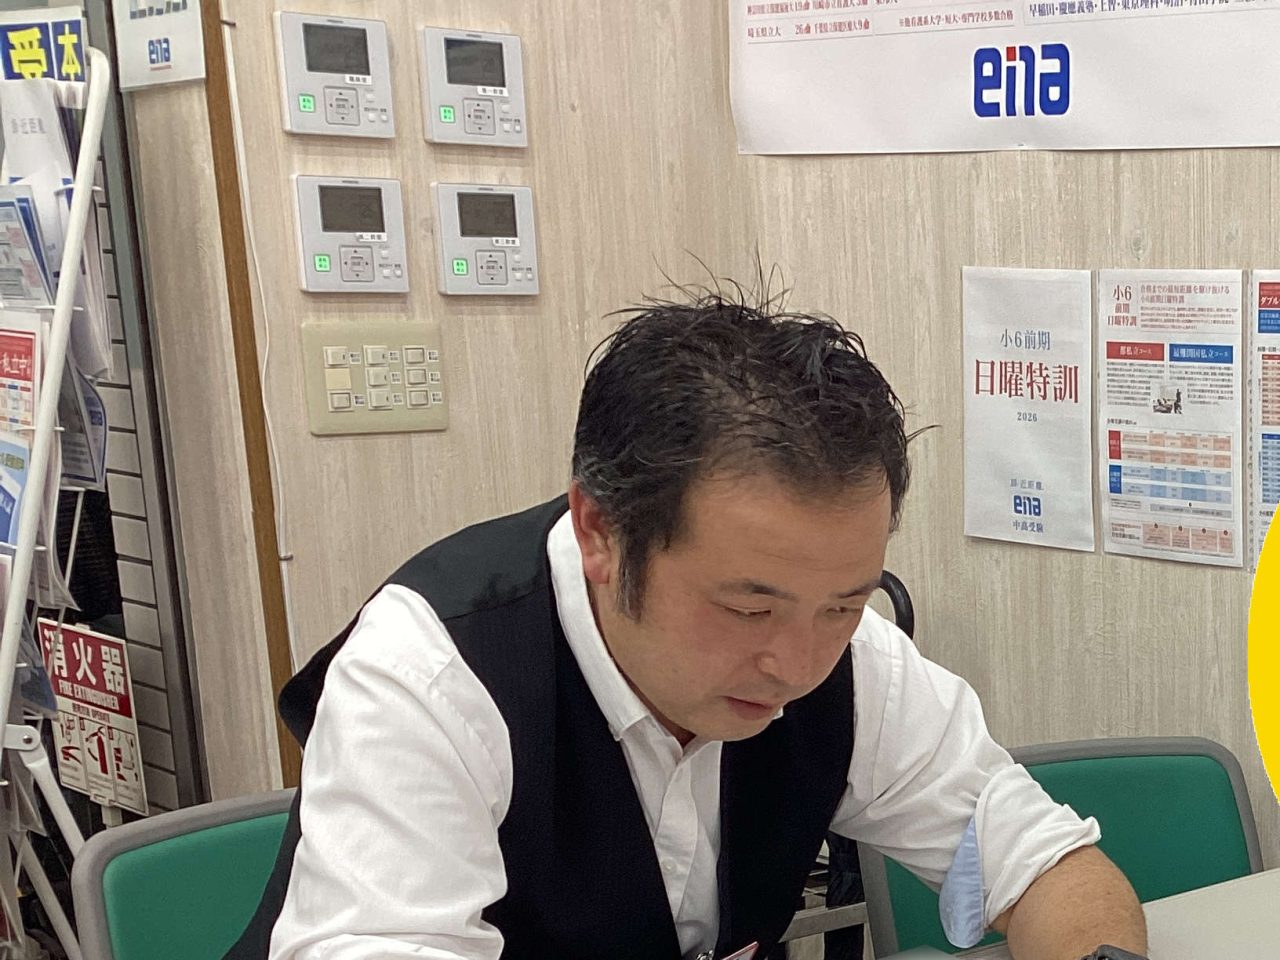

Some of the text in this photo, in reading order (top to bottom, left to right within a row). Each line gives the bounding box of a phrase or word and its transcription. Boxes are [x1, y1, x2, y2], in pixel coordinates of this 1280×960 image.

[972, 43, 1071, 118] ena
[975, 359, 1079, 404] 日曜特訓
[1013, 495, 1041, 517] ena
[44, 628, 125, 695] 消火器
